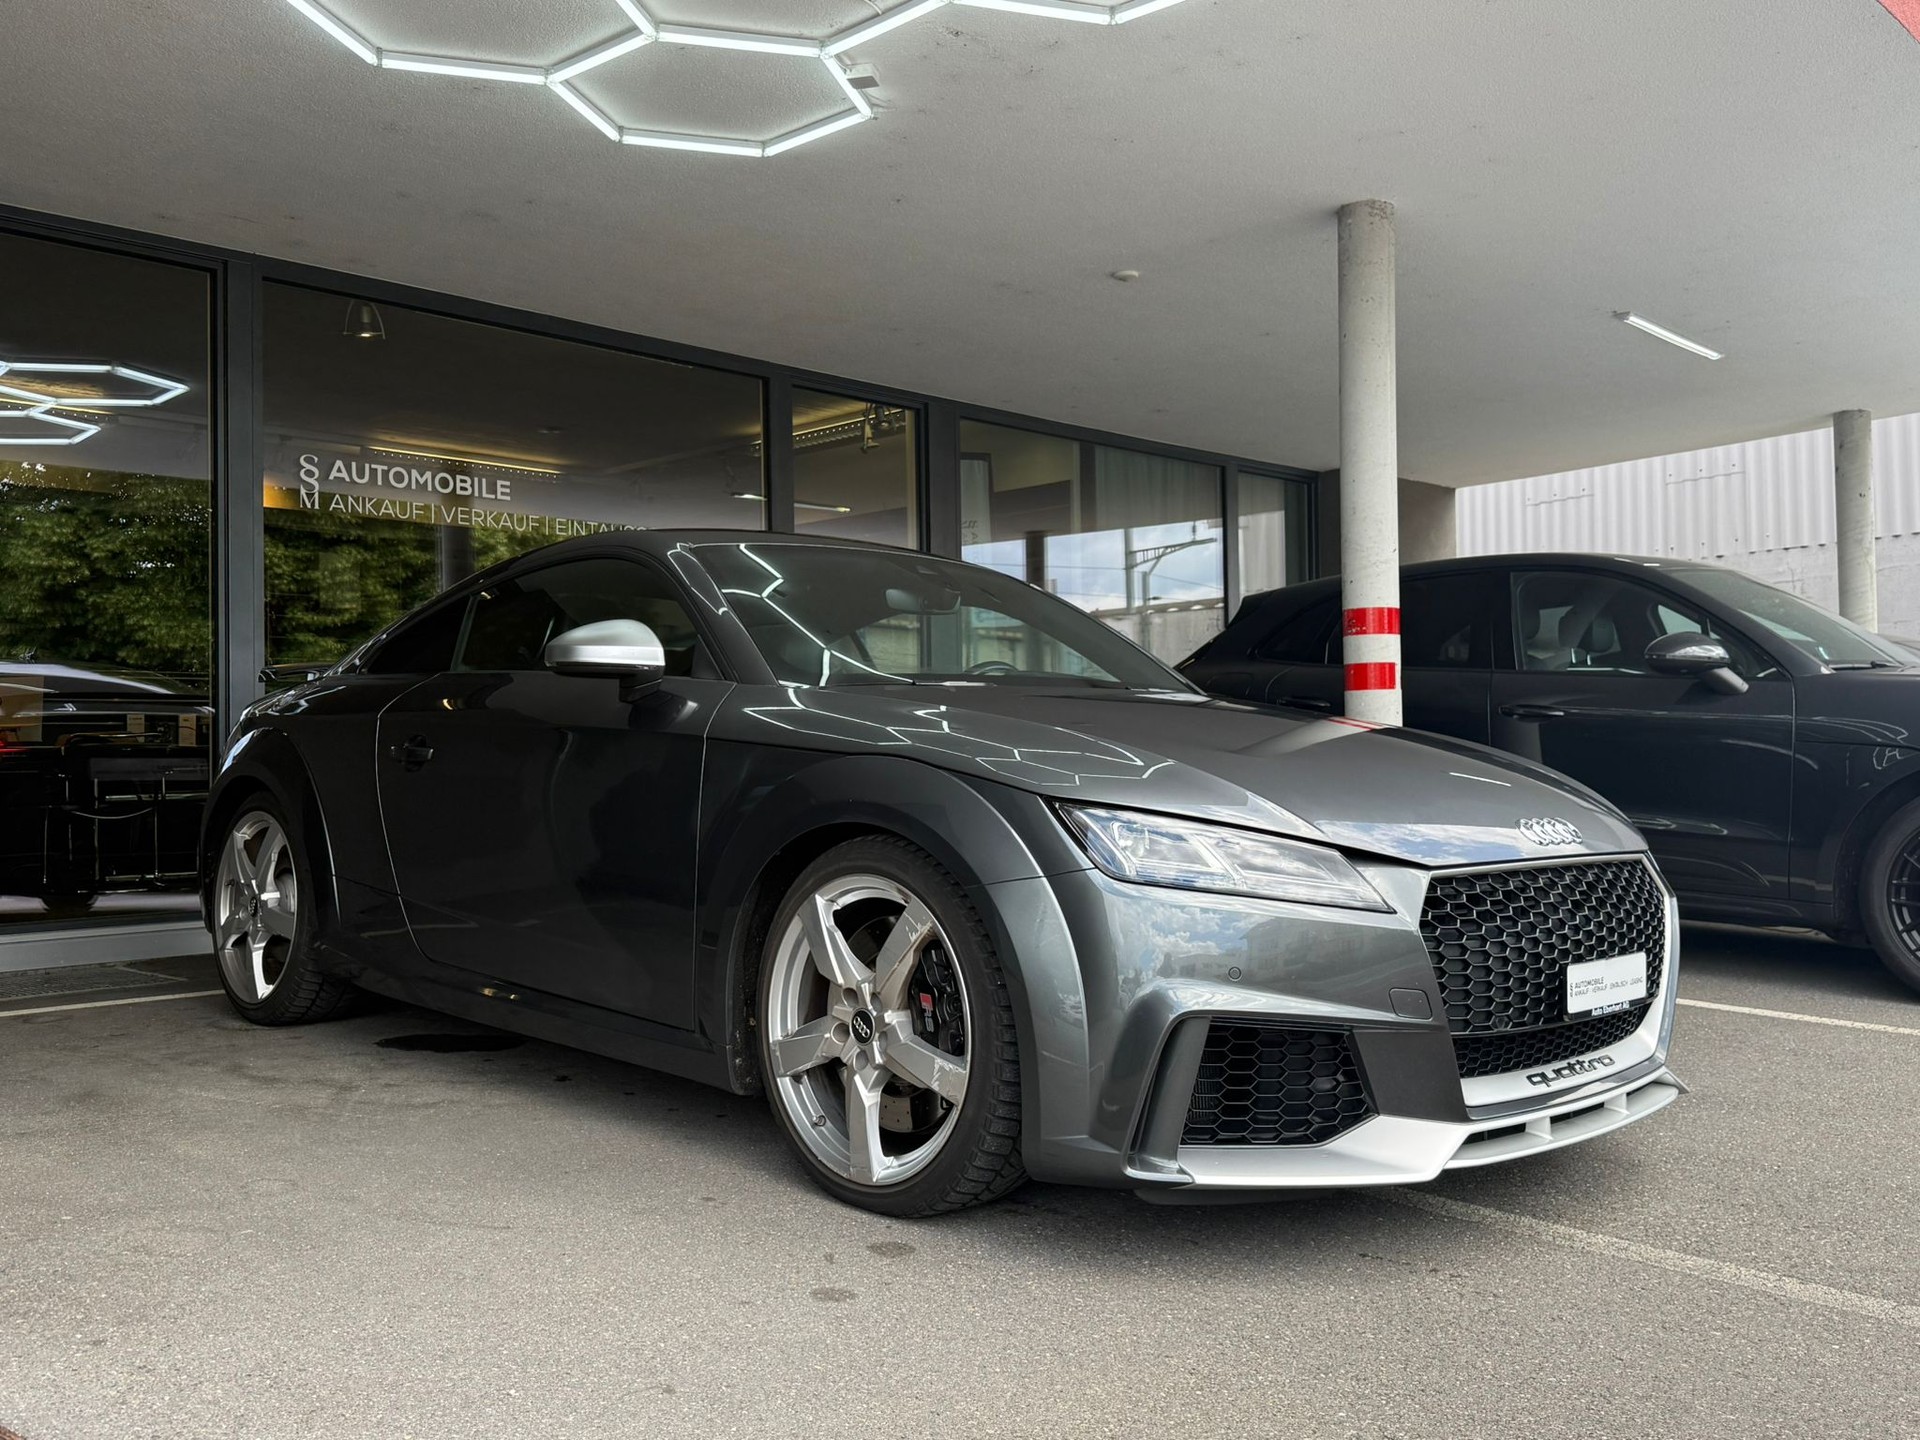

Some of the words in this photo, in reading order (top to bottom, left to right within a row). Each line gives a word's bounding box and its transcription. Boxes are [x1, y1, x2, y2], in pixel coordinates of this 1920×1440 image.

[328, 459, 511, 501] AUTOMOBILE
[329, 493, 425, 520] ANKAUF
[441, 504, 540, 532] VERKAUF
[555, 518, 656, 536] EINTA
[1526, 1054, 1616, 1087] quattro
